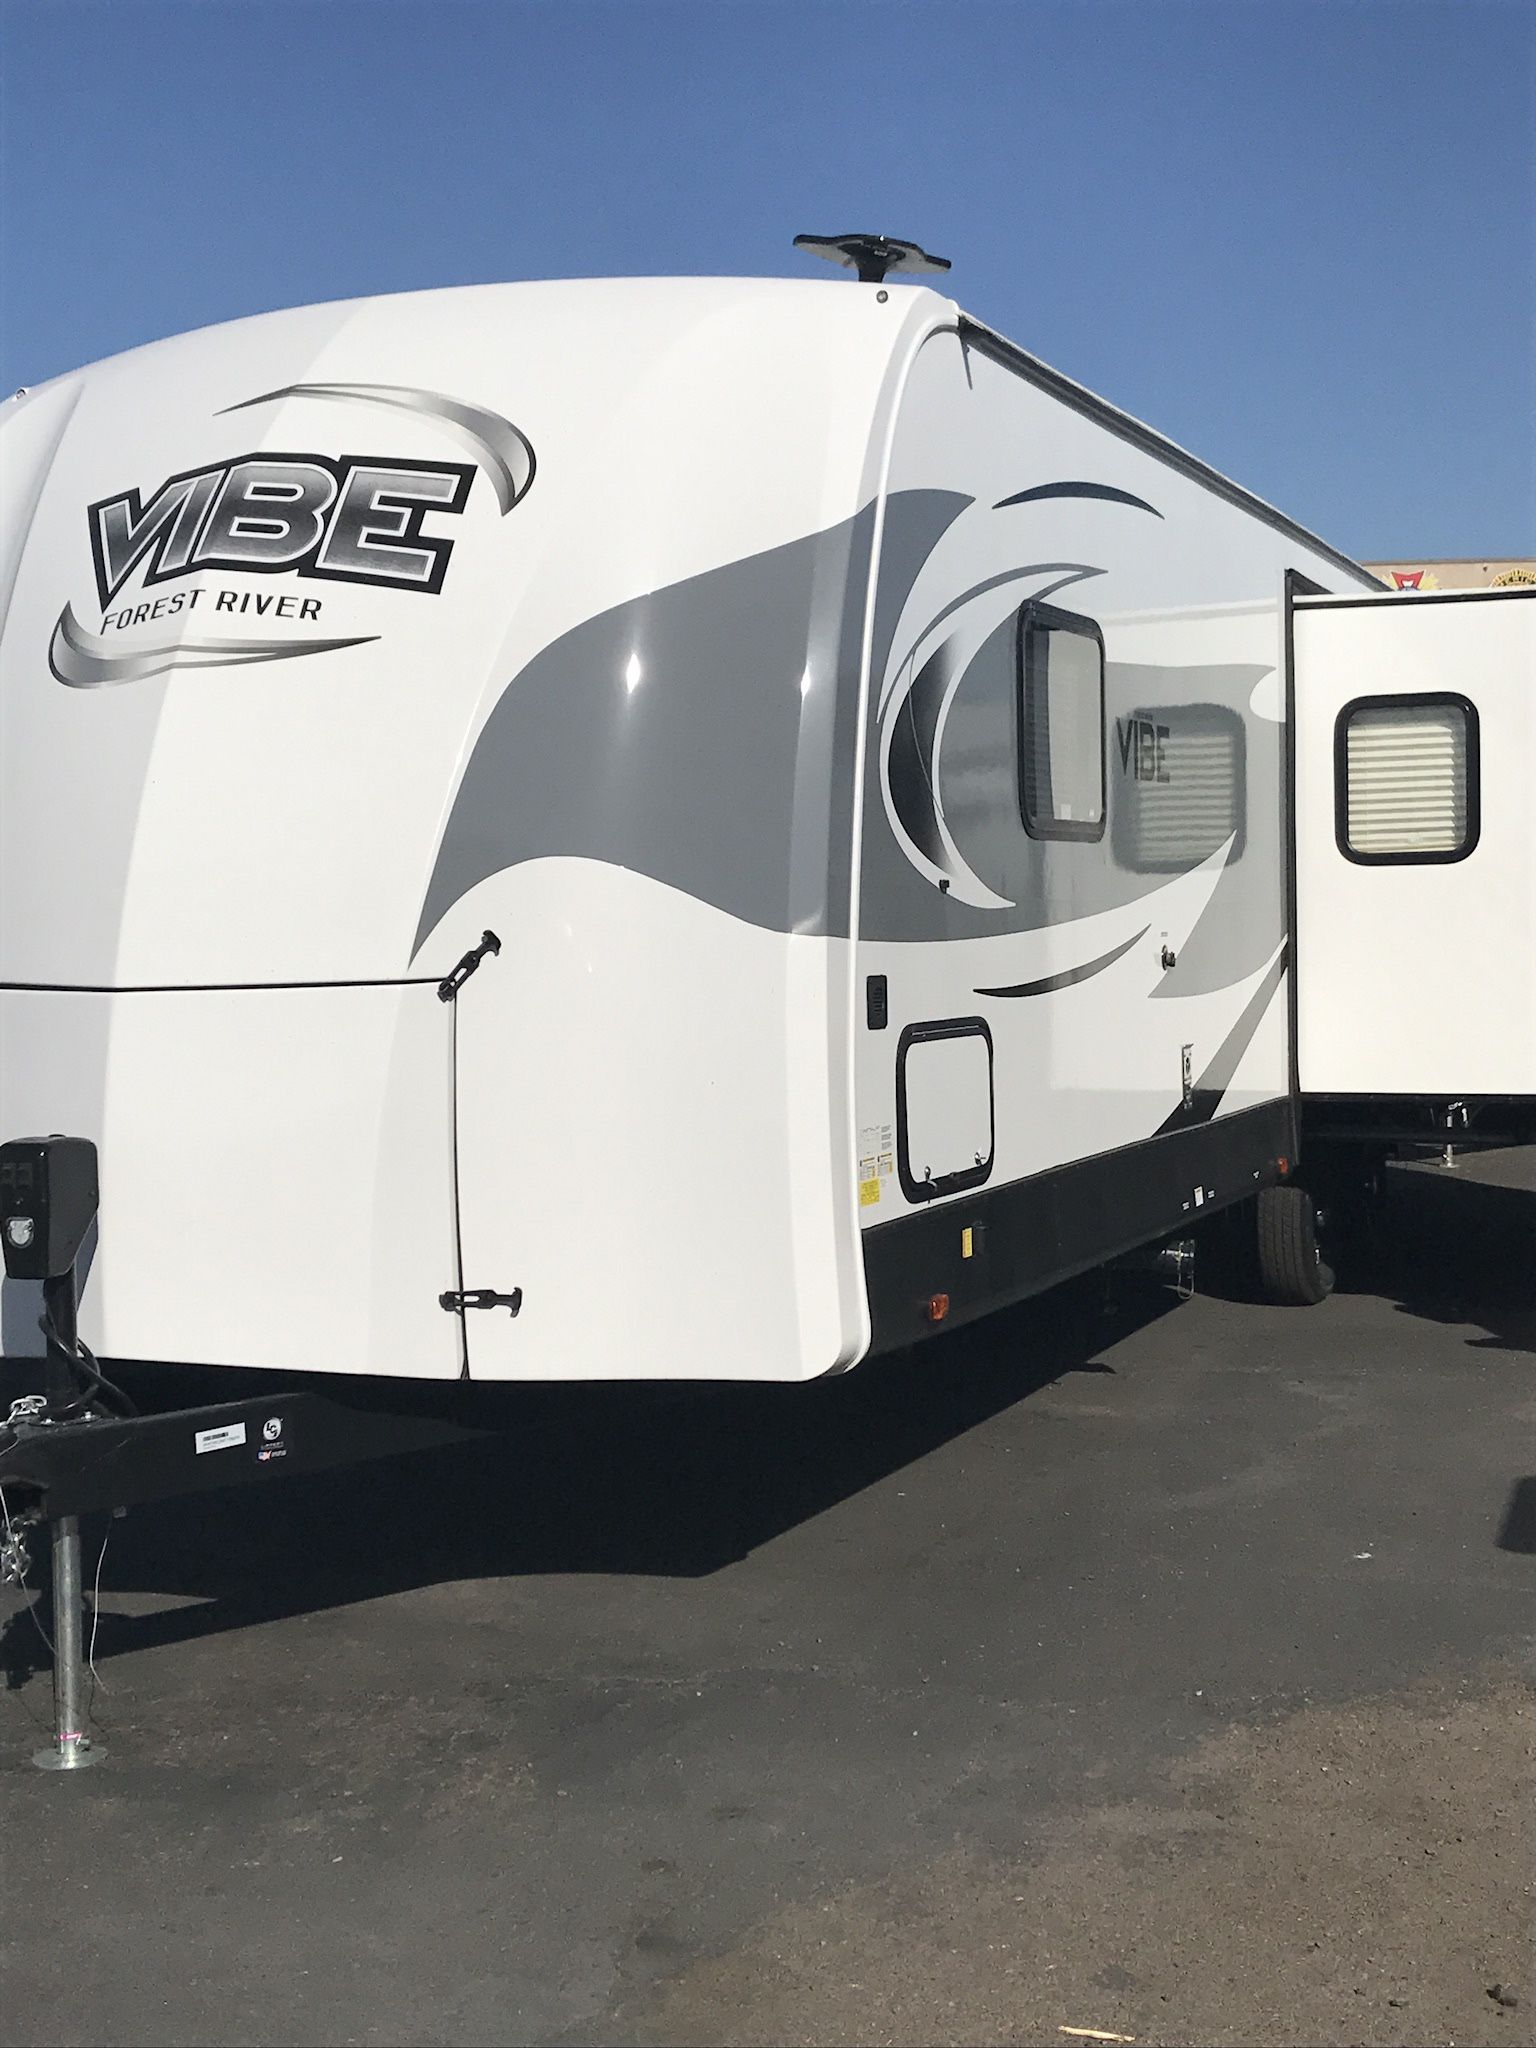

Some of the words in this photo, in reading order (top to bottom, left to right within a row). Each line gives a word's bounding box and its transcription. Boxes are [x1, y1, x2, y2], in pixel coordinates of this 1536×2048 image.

[88, 452, 477, 612] VIBE
[100, 589, 206, 636] FOREST
[215, 590, 323, 621] RIVER
[1115, 716, 1170, 783] VIBE
